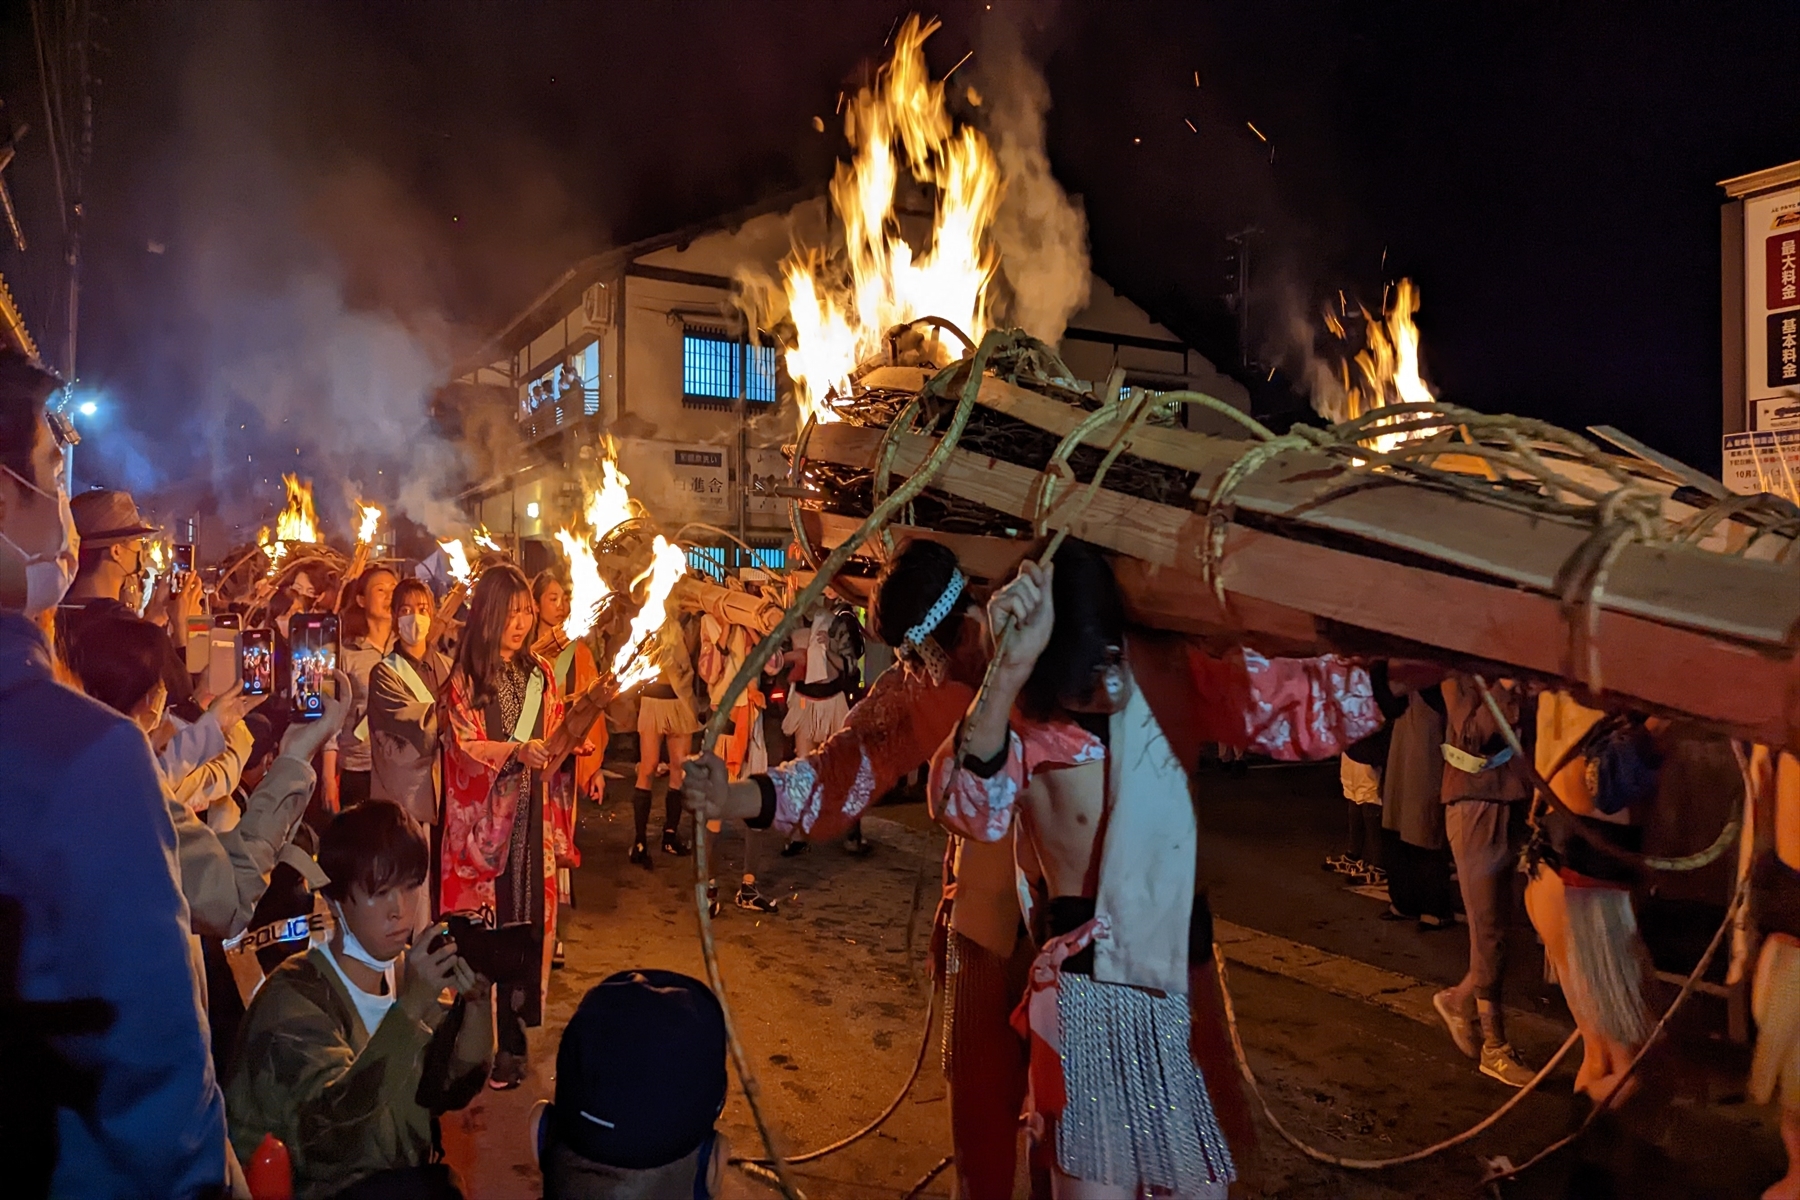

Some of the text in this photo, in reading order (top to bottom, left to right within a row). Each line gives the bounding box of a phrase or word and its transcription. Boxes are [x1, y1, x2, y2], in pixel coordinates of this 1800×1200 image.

[1781, 240, 1796, 300] 最大料金
[1782, 318, 1797, 379] 基本料金
[240, 914, 325, 954] POLICE
